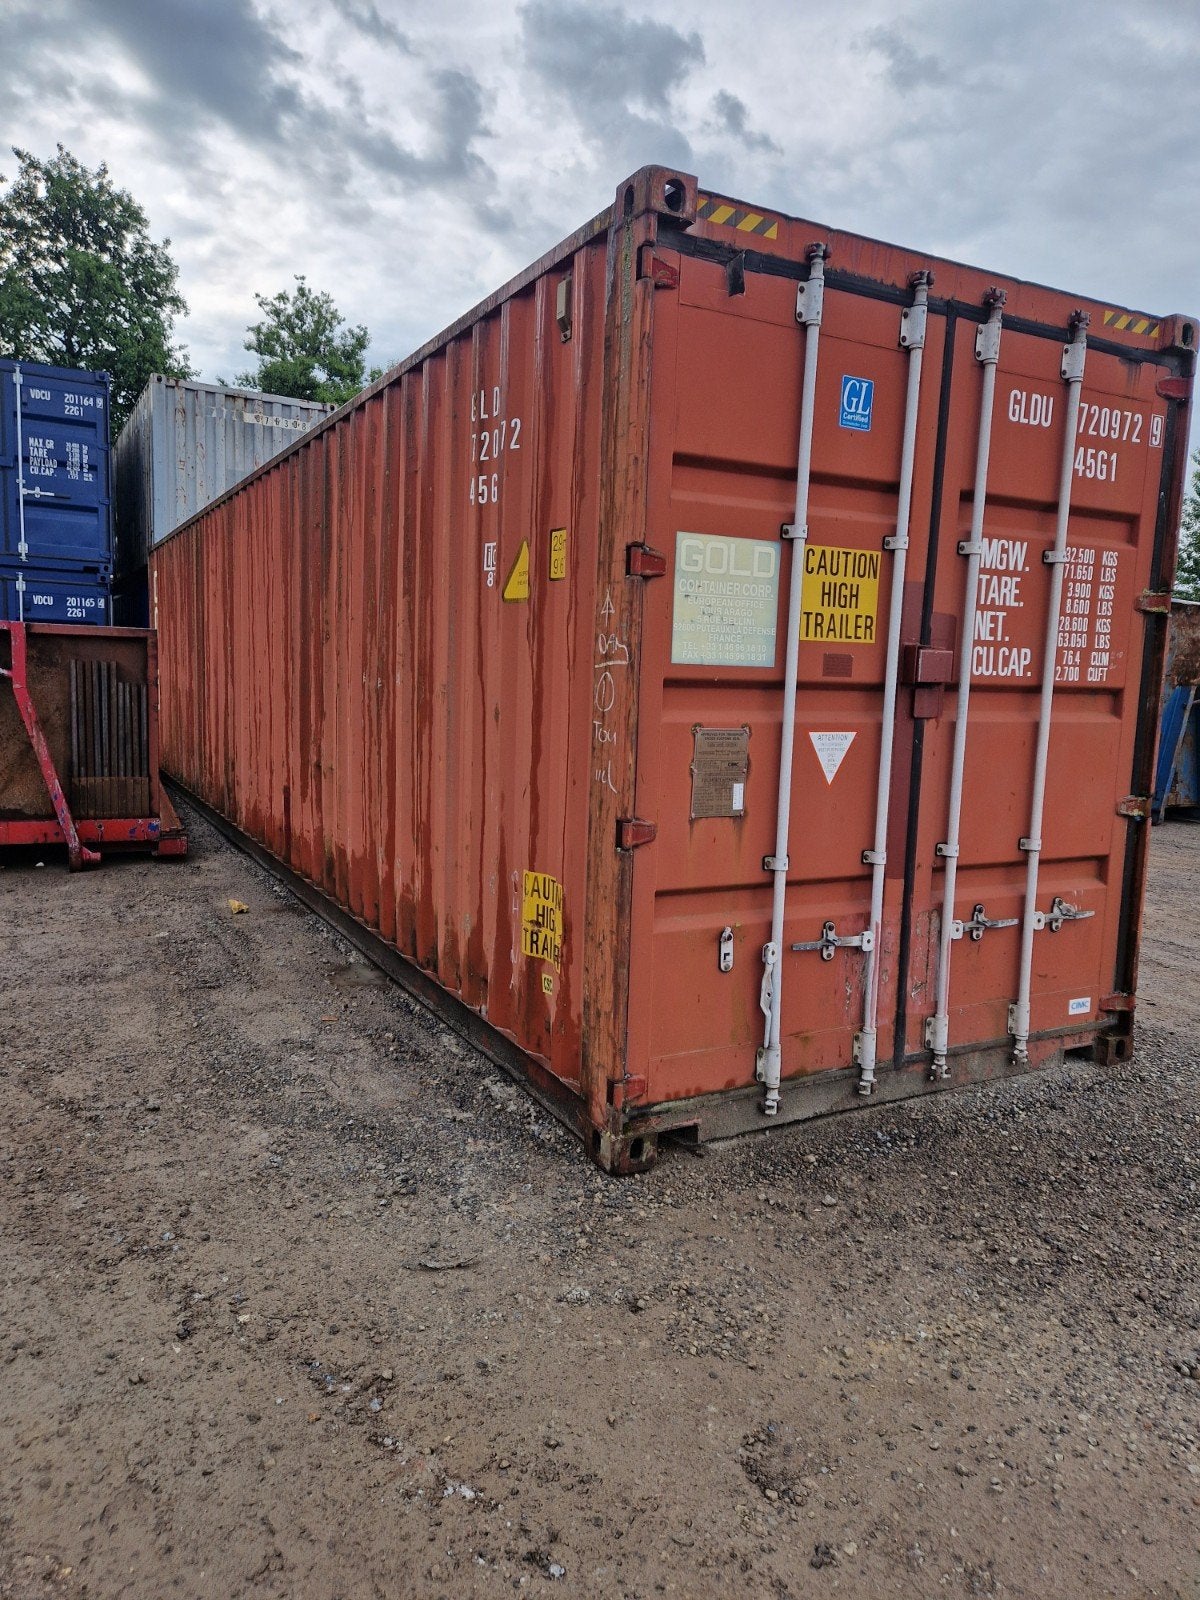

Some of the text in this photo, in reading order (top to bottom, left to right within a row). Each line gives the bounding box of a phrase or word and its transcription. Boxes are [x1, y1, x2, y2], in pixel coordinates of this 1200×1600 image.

[30, 388, 51, 401] VDCU
[64, 393, 94, 407] 201164
[843, 379, 870, 415] GL
[64, 405, 84, 416] 22G1
[843, 412, 869, 423] Certified
[1008, 389, 1163, 447] GLDU 720972 9
[29, 447, 49, 458] TARE
[29, 457, 58, 469] PAYLOAD
[1074, 446, 1118, 482] 45G1
[680, 539, 776, 578] GOLD
[805, 548, 879, 579] CAUTION
[980, 538, 1119, 571] MGW. 32.500 KGS
[1064, 563, 1117, 582] 71.650 LBS
[680, 578, 774, 598] CONTAINER CORP.
[821, 581, 860, 609] HIGH
[979, 574, 1115, 607] TARE. 3.900 KGS
[32, 594, 53, 606] VDCU
[66, 597, 95, 607] 201165
[688, 597, 764, 609] EUROPEAN OFFICE
[1066, 598, 1113, 616] 8.600 LBS
[67, 607, 86, 617] 22G1
[803, 611, 874, 640] TRAILER
[974, 610, 1111, 641] NET. 28.600 KGS
[683, 641, 698, 650] TEL
[708, 633, 742, 642] FRANCE
[1058, 632, 1110, 649] 63.050 LBS
[682, 650, 699, 659] FAX
[972, 646, 1032, 677] CU.CAP.
[1062, 650, 1081, 665] 76.4
[1055, 666, 1080, 681] 2.700
[816, 733, 848, 741] ATTENTION
